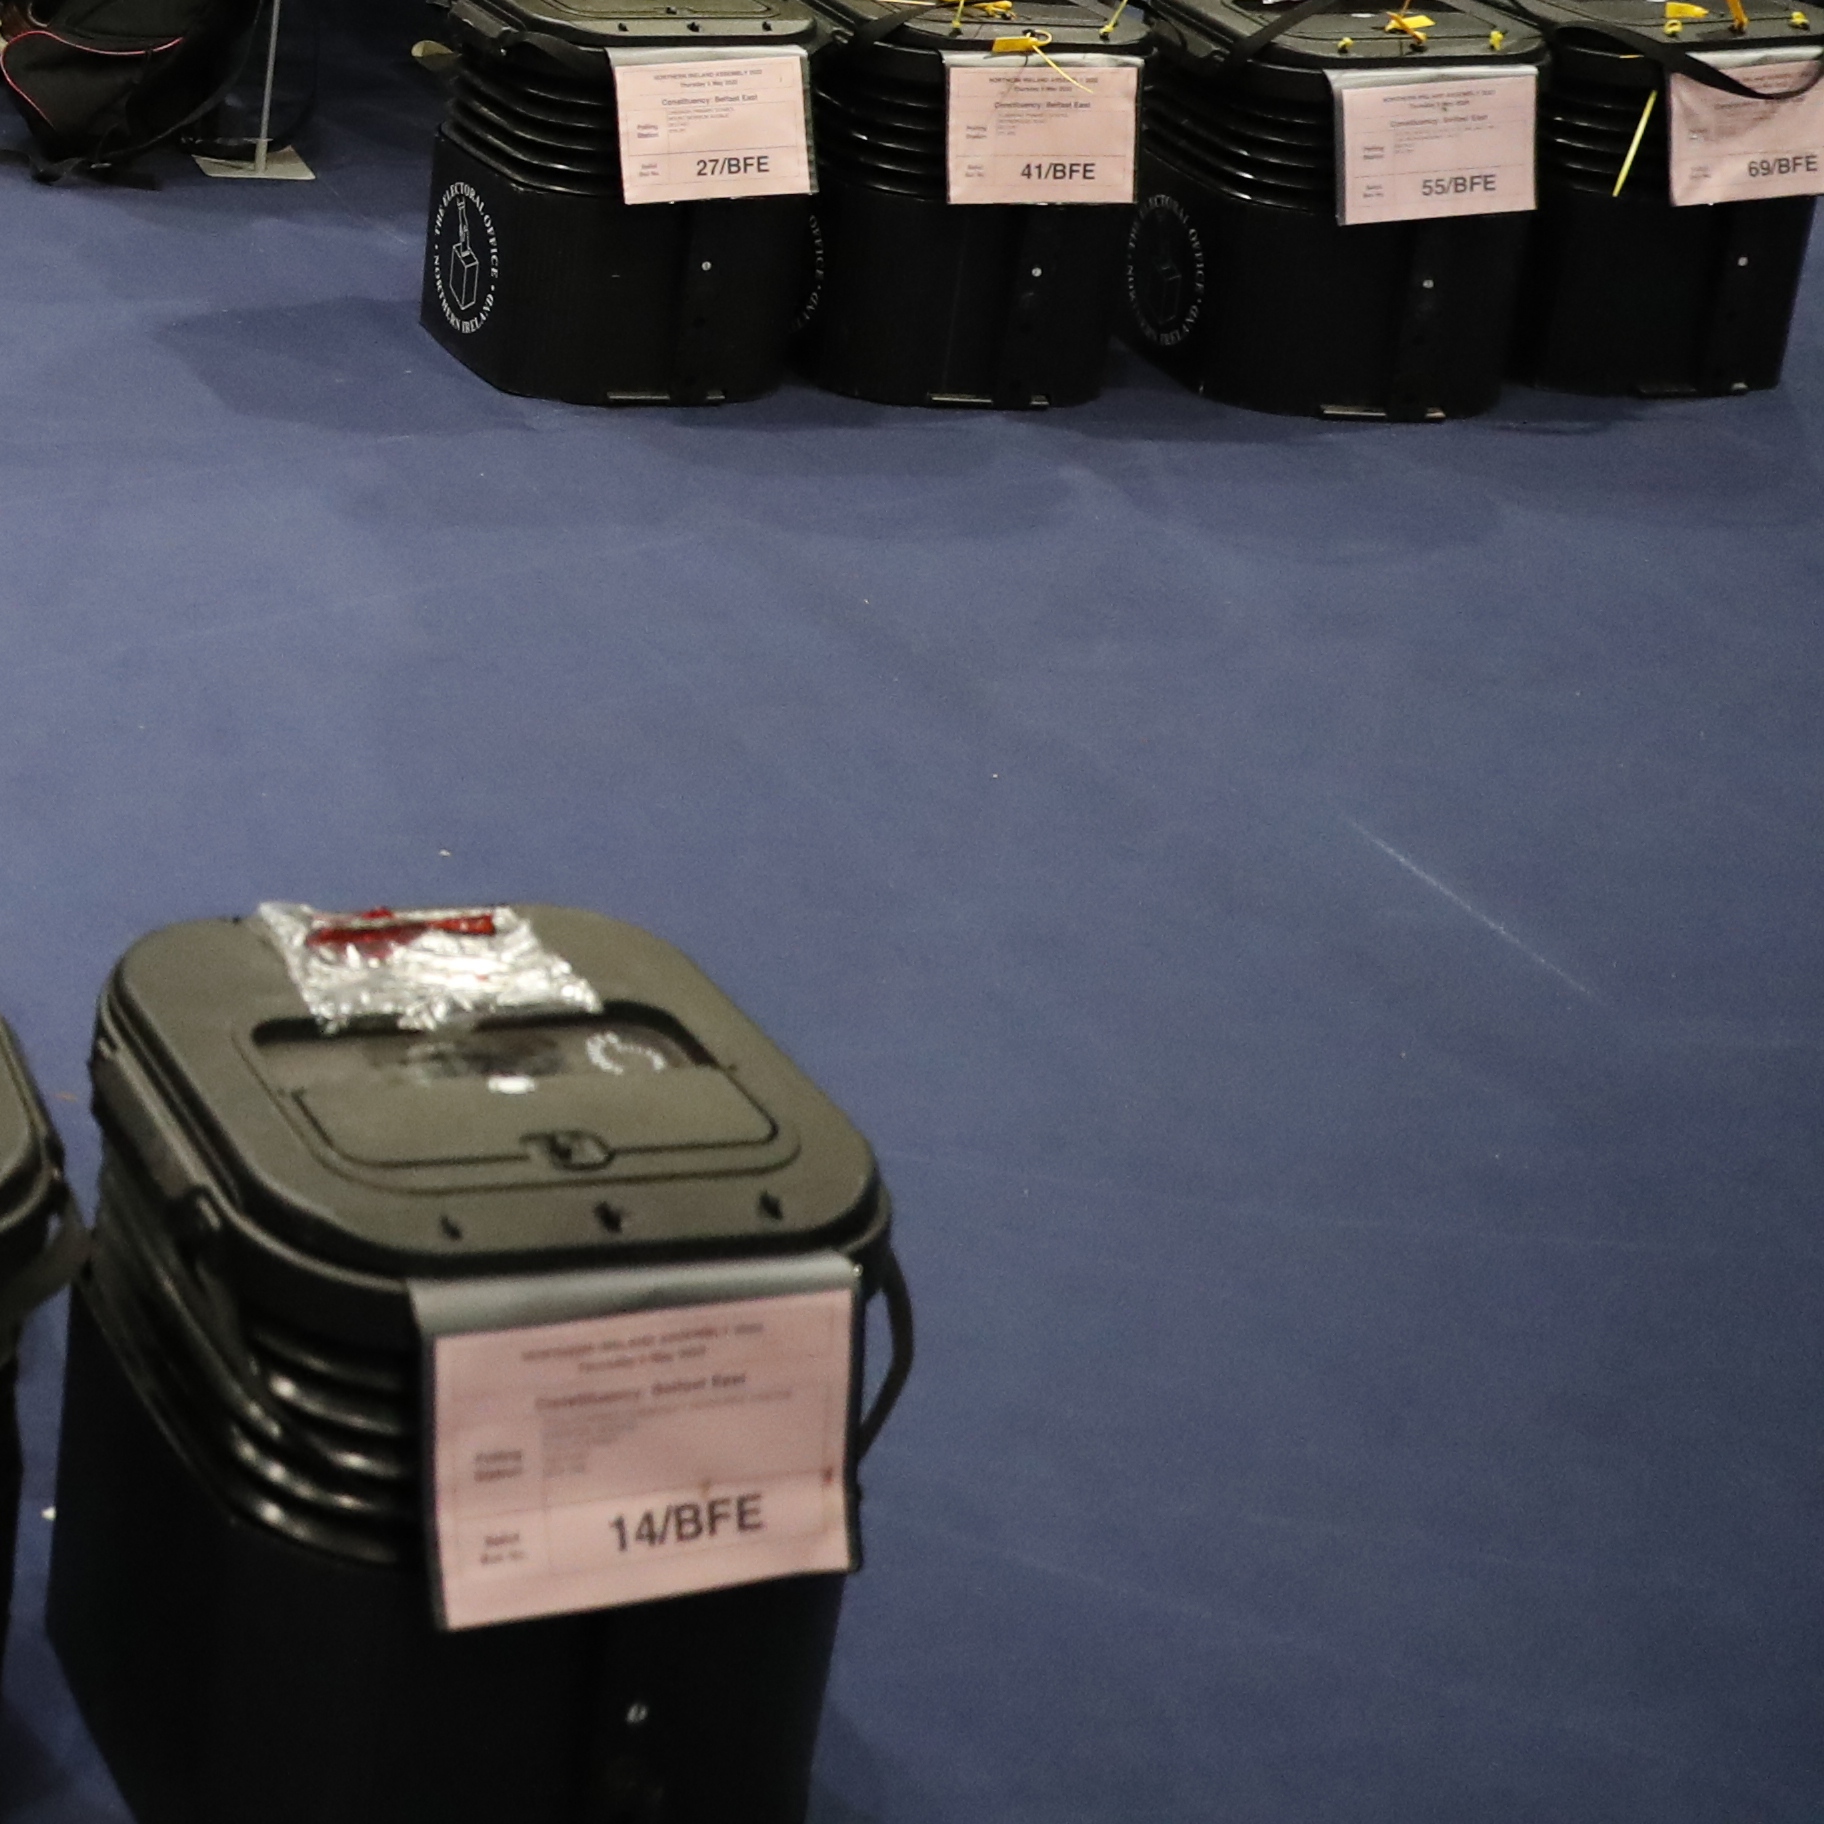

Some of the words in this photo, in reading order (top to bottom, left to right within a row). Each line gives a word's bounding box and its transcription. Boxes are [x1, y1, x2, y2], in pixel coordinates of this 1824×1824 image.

[696, 155, 770, 176] 27/BFE
[1020, 162, 1096, 180] 41/BFE
[1748, 155, 1818, 177] 69/BFE
[1421, 174, 1496, 196] 55/BFE
[609, 1492, 764, 1552] 14/BFE
